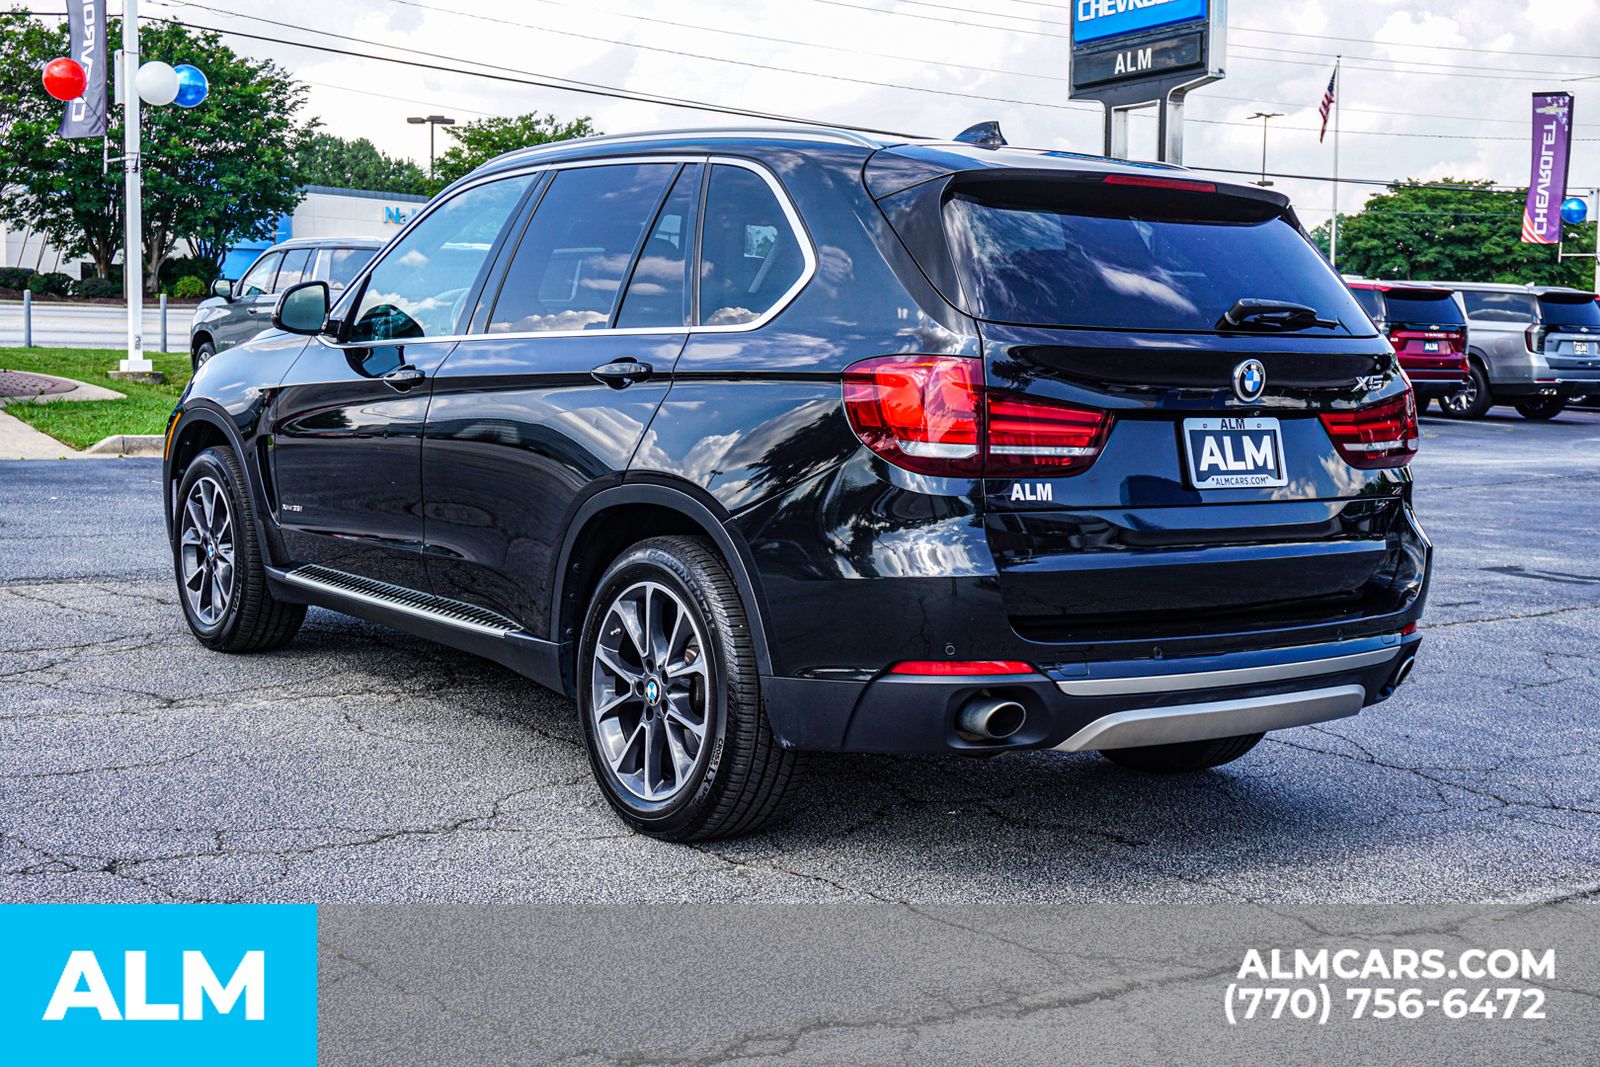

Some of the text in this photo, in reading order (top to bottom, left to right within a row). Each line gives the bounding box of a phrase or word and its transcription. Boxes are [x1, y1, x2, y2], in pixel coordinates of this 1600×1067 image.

[1114, 48, 1152, 75] ALM
[1424, 342, 1439, 351] ALM
[1350, 374, 1384, 393] X5
[1220, 418, 1246, 430] ALM
[1199, 435, 1275, 471] ALM
[1010, 482, 1053, 502] ALM
